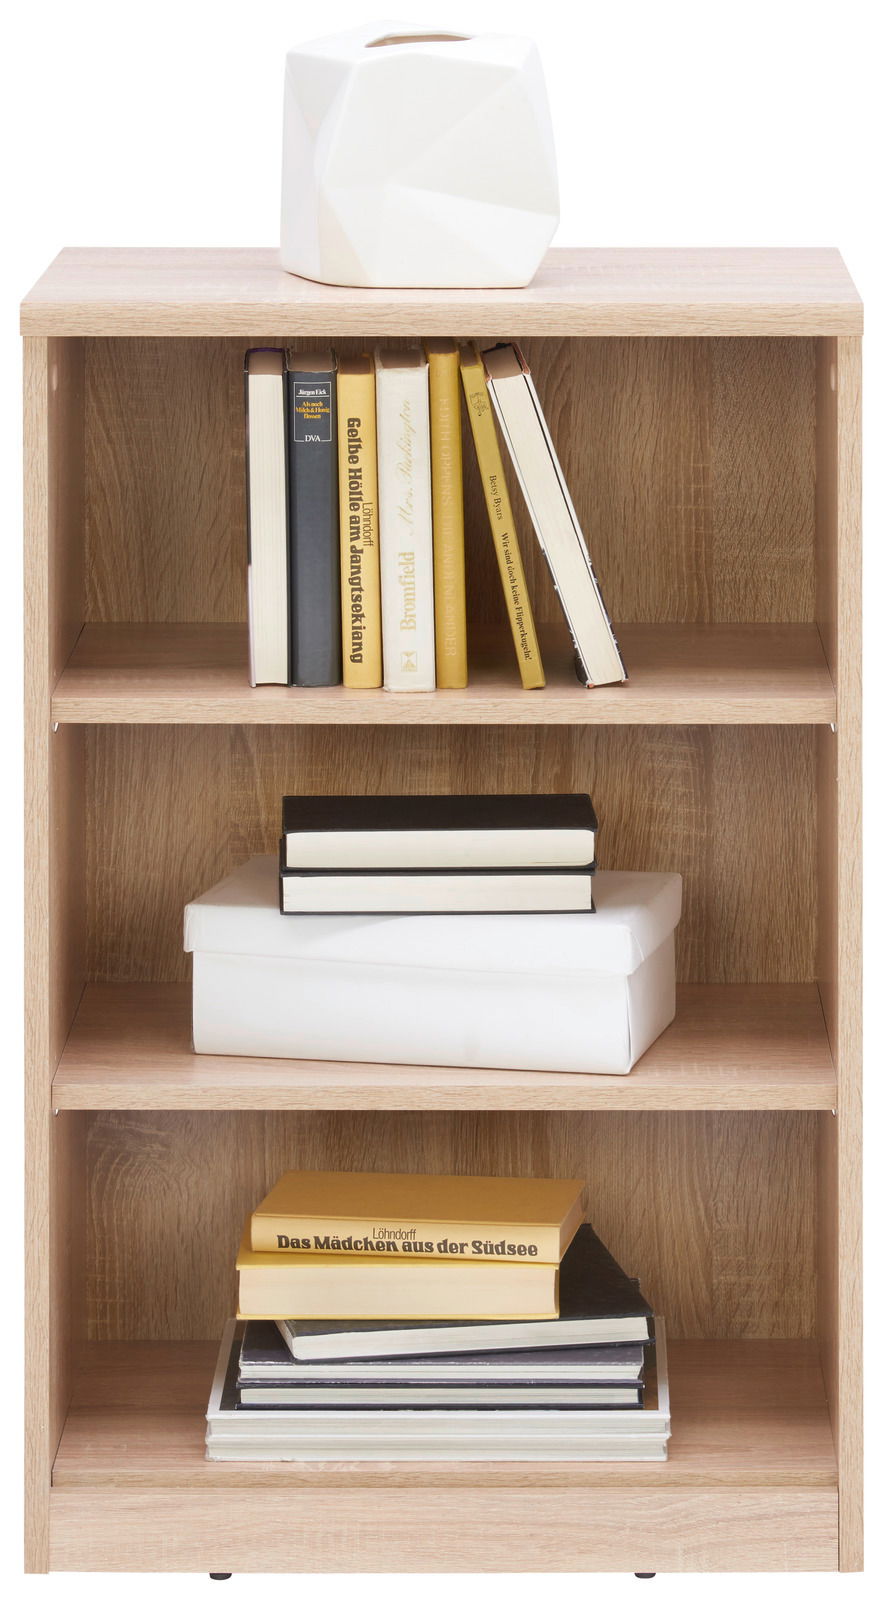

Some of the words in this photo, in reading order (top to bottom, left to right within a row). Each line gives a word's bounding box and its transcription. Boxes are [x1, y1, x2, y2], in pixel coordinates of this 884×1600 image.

[440, 398, 451, 440] EDITH
[347, 418, 362, 464] Gelbe
[348, 468, 364, 512] Hölle
[490, 475, 498, 496] Betsy
[494, 498, 504, 521] Byars
[349, 515, 362, 542] am
[362, 502, 374, 546] Löhndorff
[501, 532, 510, 548] Wir
[504, 549, 513, 565] sind
[508, 566, 517, 584] doch
[398, 552, 416, 630] Bromfield
[511, 586, 520, 606] keine
[348, 545, 366, 664] Jangtsekiang
[516, 606, 532, 660] Flipperkugeln!
[277, 1234, 311, 1250] Das
[313, 1236, 398, 1252] Mädchen
[402, 1240, 434, 1253] aus
[436, 1238, 469, 1254] der
[472, 1240, 538, 1256] Südsee
[372, 1228, 416, 1240] Löhndorff
